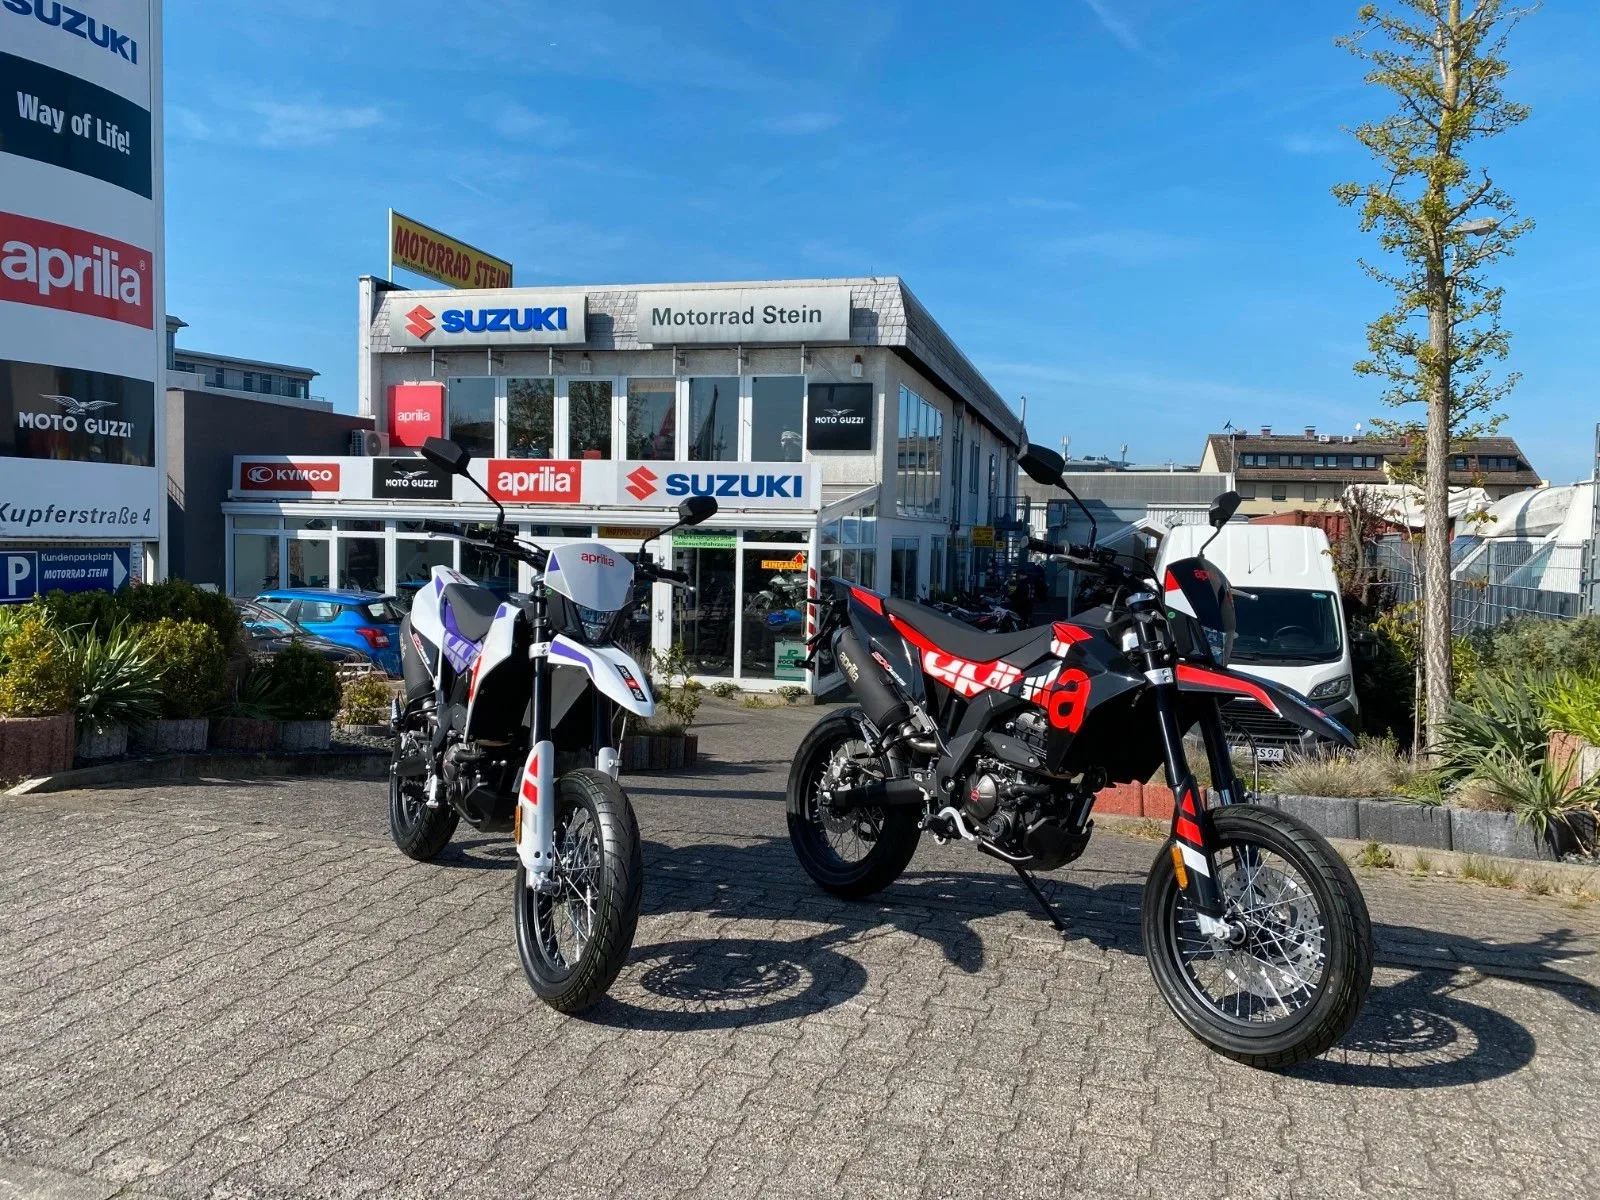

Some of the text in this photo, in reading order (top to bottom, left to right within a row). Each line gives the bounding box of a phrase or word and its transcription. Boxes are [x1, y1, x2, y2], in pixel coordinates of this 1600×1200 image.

[3, 0, 138, 65] SUZUKI
[17, 91, 130, 155] Way of Life!
[394, 225, 510, 288] MOTORRAD STEIN
[1, 240, 142, 306] aprilia
[441, 306, 568, 333] SUZUKI
[652, 305, 822, 326] Motorrad Stein
[19, 411, 131, 438] MOTO GUZZI
[397, 410, 431, 423] aprilia
[815, 416, 864, 424] MOTO GUZZI
[276, 469, 333, 481] KYMCO
[385, 479, 437, 488] MOTO GUZZI
[497, 466, 571, 493] aprilia
[666, 473, 802, 499] SUZUKI
[0, 502, 150, 527] Kupferstraße 4
[41, 553, 112, 563] Kundenparkplatz
[581, 552, 615, 568] aprilia
[7, 556, 31, 596] P
[44, 568, 109, 579] MOTORRAD STEIN
